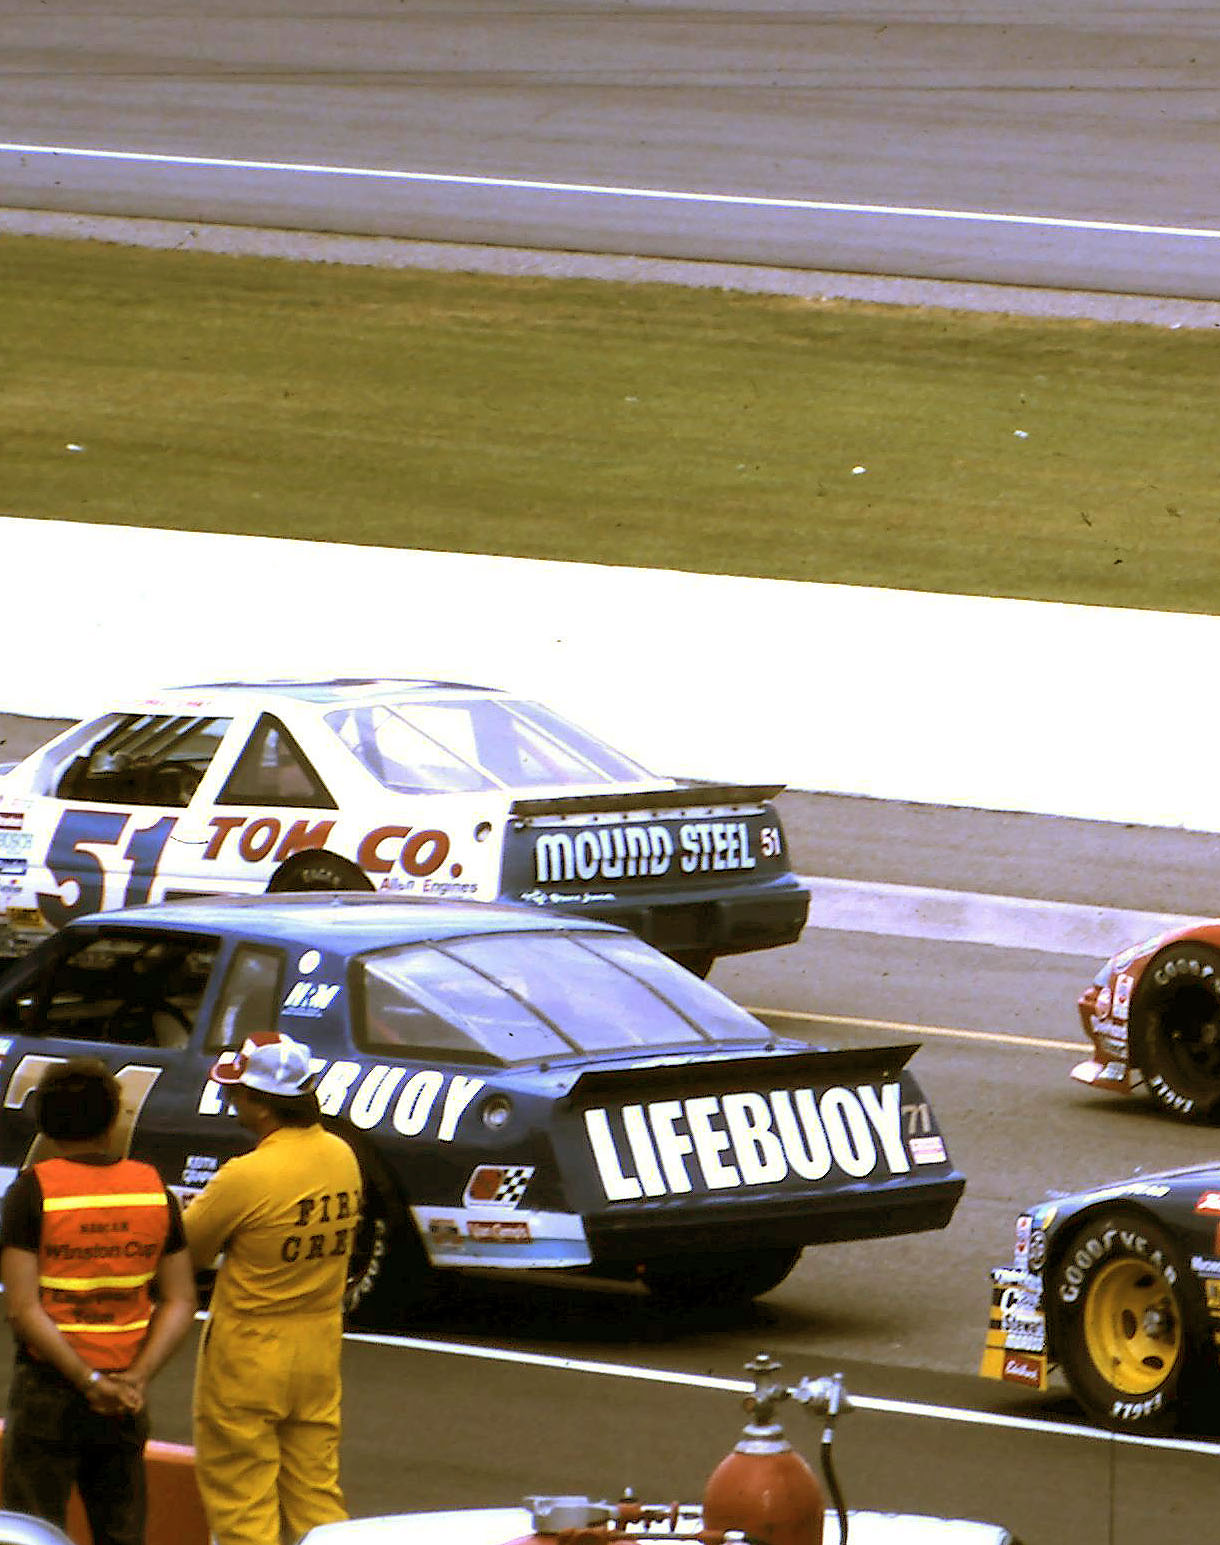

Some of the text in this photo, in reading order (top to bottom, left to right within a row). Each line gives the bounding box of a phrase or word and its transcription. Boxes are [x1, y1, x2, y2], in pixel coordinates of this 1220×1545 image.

[36, 808, 179, 930] 51
[202, 816, 336, 862] TOM
[357, 825, 463, 878] CO.
[535, 822, 756, 883] MOUND STEEL
[759, 827, 782, 857] 51
[584, 1082, 911, 1202] LIFEBUOY
[294, 1188, 360, 1228] FIR
